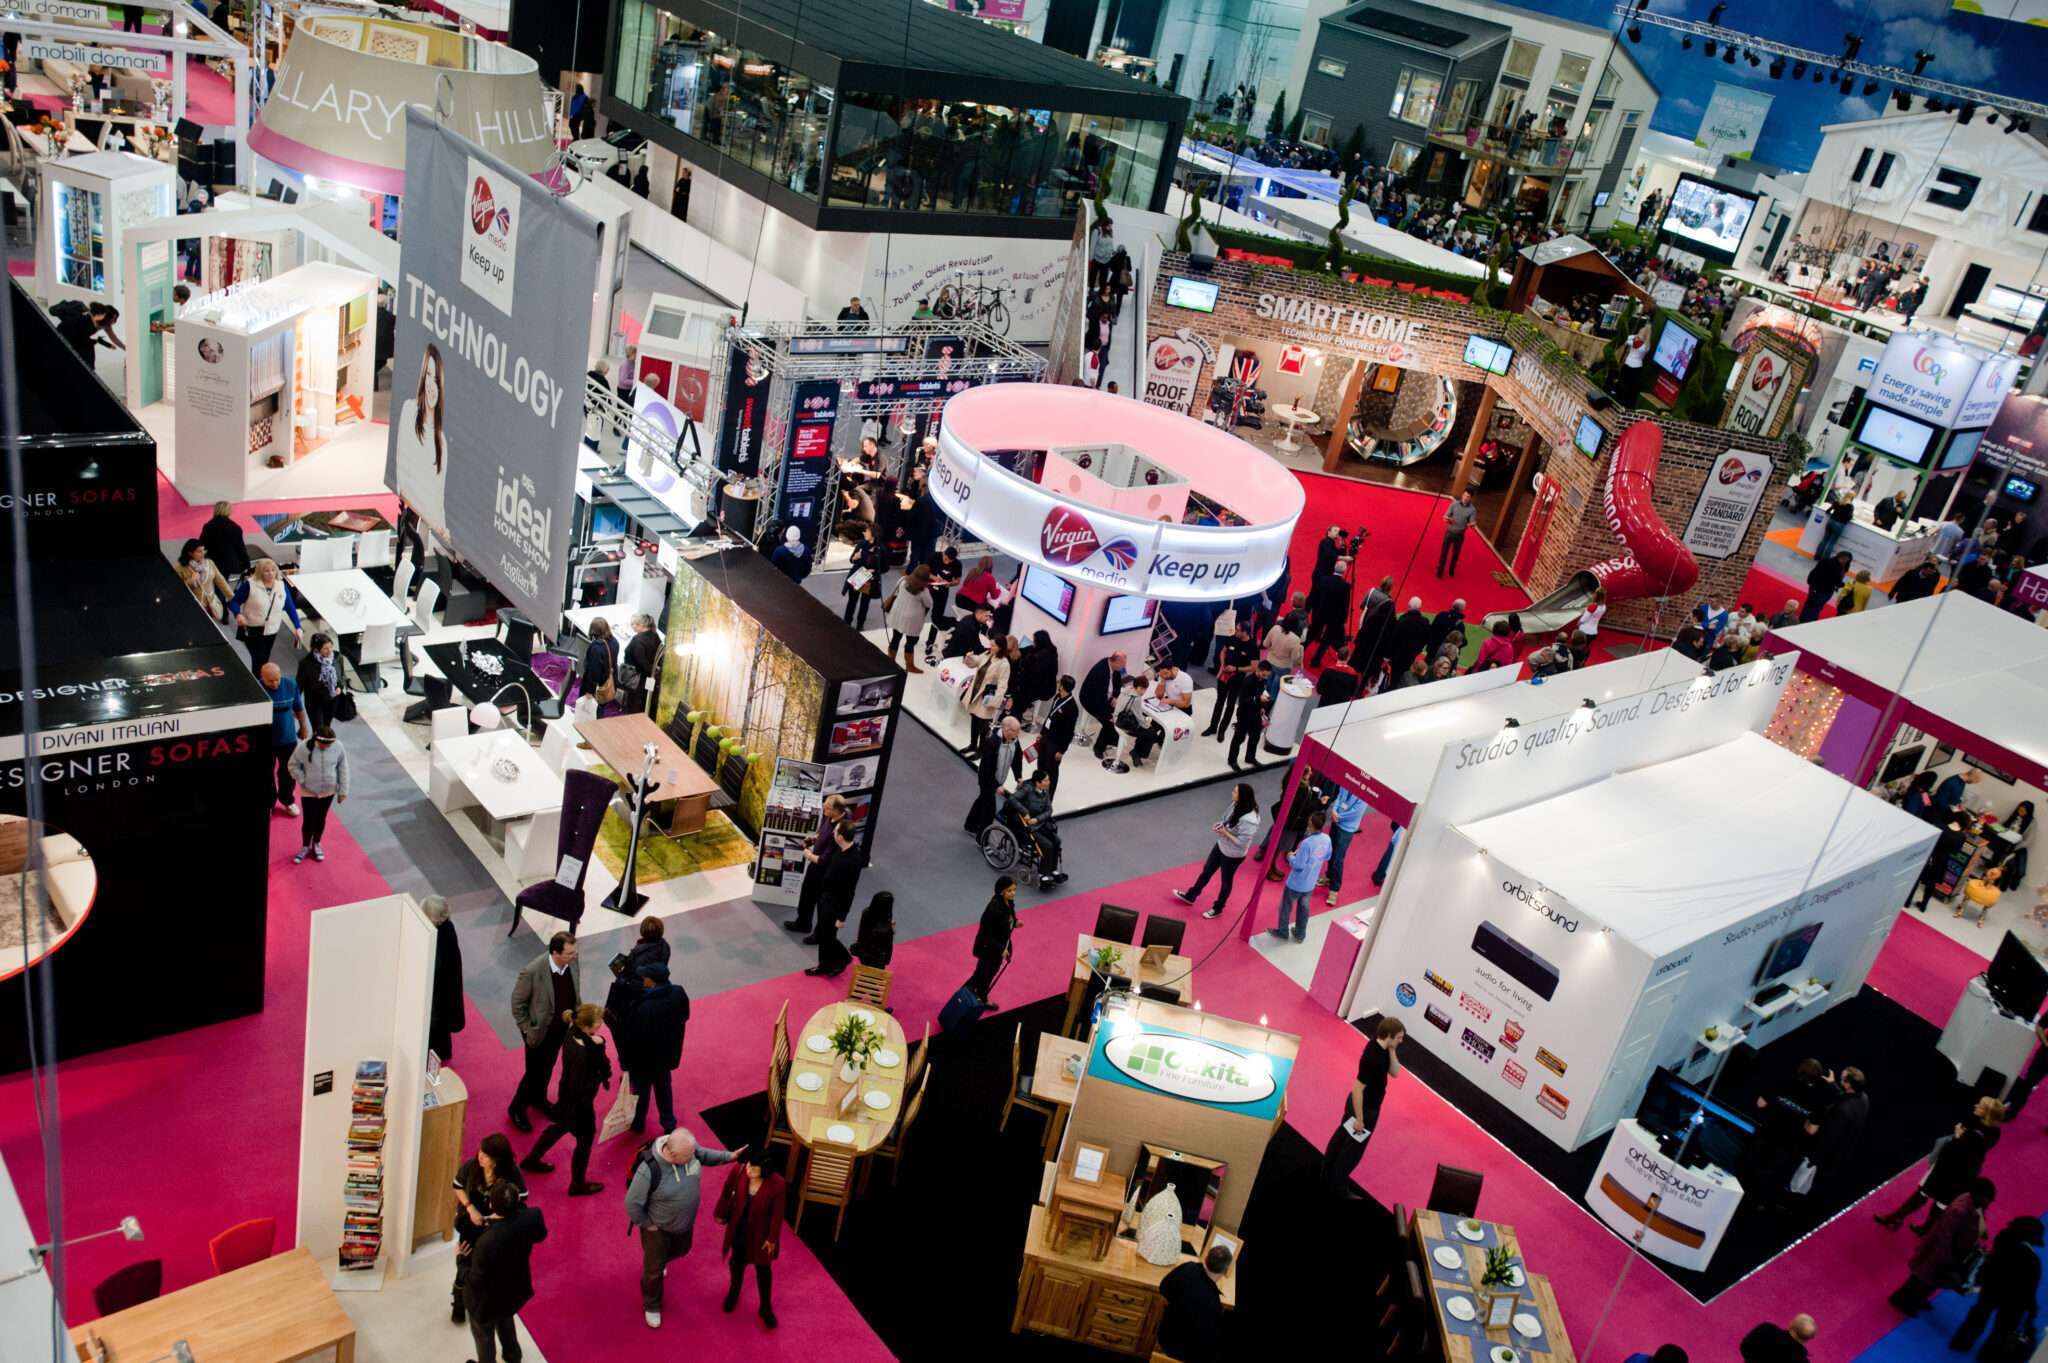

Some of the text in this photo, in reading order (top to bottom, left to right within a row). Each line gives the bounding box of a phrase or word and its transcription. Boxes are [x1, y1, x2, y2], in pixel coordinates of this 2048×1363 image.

[35, 1, 100, 19] domani
[30, 44, 159, 70] mobili domani
[472, 184, 495, 229] Virgin
[468, 244, 505, 283] Keep up
[925, 263, 946, 279] Quiet
[948, 253, 993, 269] Revolution
[1255, 293, 1423, 346] SMART HOME
[406, 273, 564, 430] TECHNOLOGY
[1146, 381, 1189, 401] ROOF
[1878, 386, 1945, 418] made simple
[1881, 373, 1952, 409] Energy saving
[69, 487, 138, 505] SOFAS
[953, 478, 971, 503] up
[495, 464, 552, 560] ideal
[1702, 506, 1745, 522] STANDARD
[494, 514, 550, 575] HOME SHOW
[1043, 511, 1096, 562] Virgin
[499, 553, 529, 592] Anglian
[1147, 553, 1241, 585] Keep up
[143, 665, 225, 687] SOFAS
[42, 718, 180, 750] DIVANI ITALIANI
[1455, 735, 1518, 770] Studio
[1523, 718, 1582, 759] quality
[1586, 704, 1640, 734] Sound.
[1649, 678, 1720, 716] Designed
[1722, 670, 1748, 696] for
[149, 733, 250, 767] SOFAS
[63, 774, 156, 797] LONDON
[1502, 880, 1579, 934] orbitsound
[1475, 967, 1497, 985] audio
[1498, 981, 1512, 993] for
[1512, 991, 1534, 1013] living
[1181, 1074, 1226, 1091] Furniture
[1628, 1147, 1710, 1200] orbitsound
